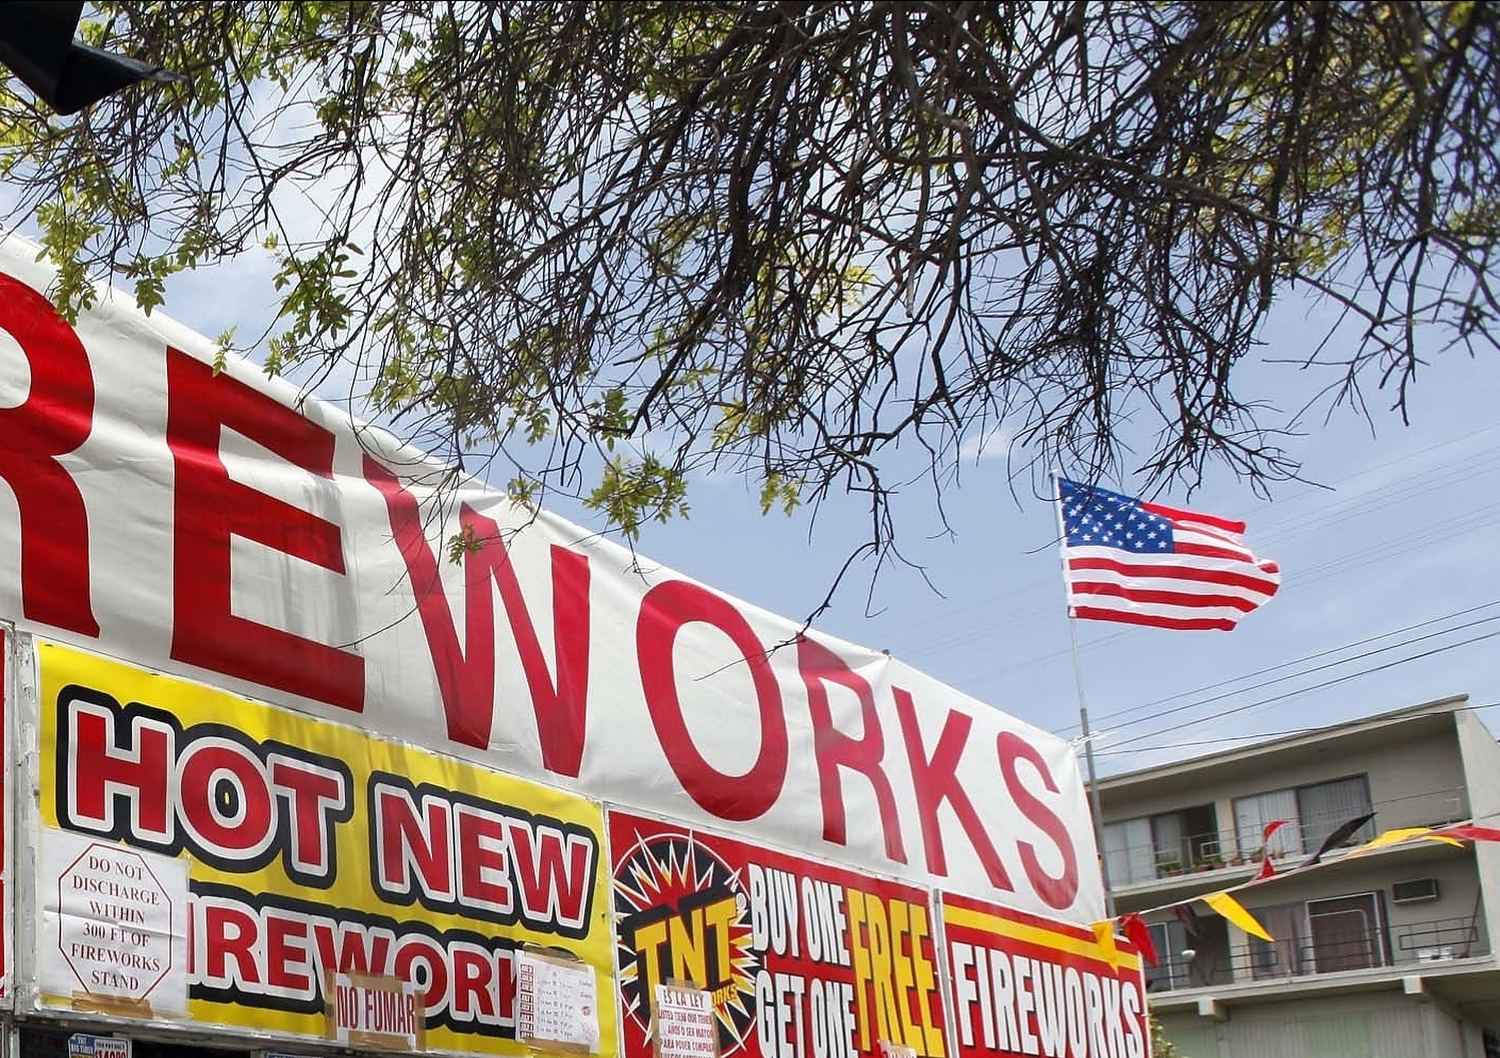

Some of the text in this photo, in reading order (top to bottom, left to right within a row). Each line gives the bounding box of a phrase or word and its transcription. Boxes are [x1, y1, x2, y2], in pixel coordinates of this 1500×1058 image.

[67, 698, 348, 879] HOT
[89, 856, 145, 881] DO NOT
[372, 781, 595, 930] NEW
[72, 875, 160, 906] DISCHARGE
[89, 900, 145, 924] WITHIN
[747, 862, 851, 968] BUY ONE
[83, 922, 150, 948] 300 FT OF
[634, 896, 739, 998] TNT
[71, 943, 160, 972] FIREWORKS
[91, 970, 139, 991] STAND
[337, 985, 415, 1034] NO FUMAR
